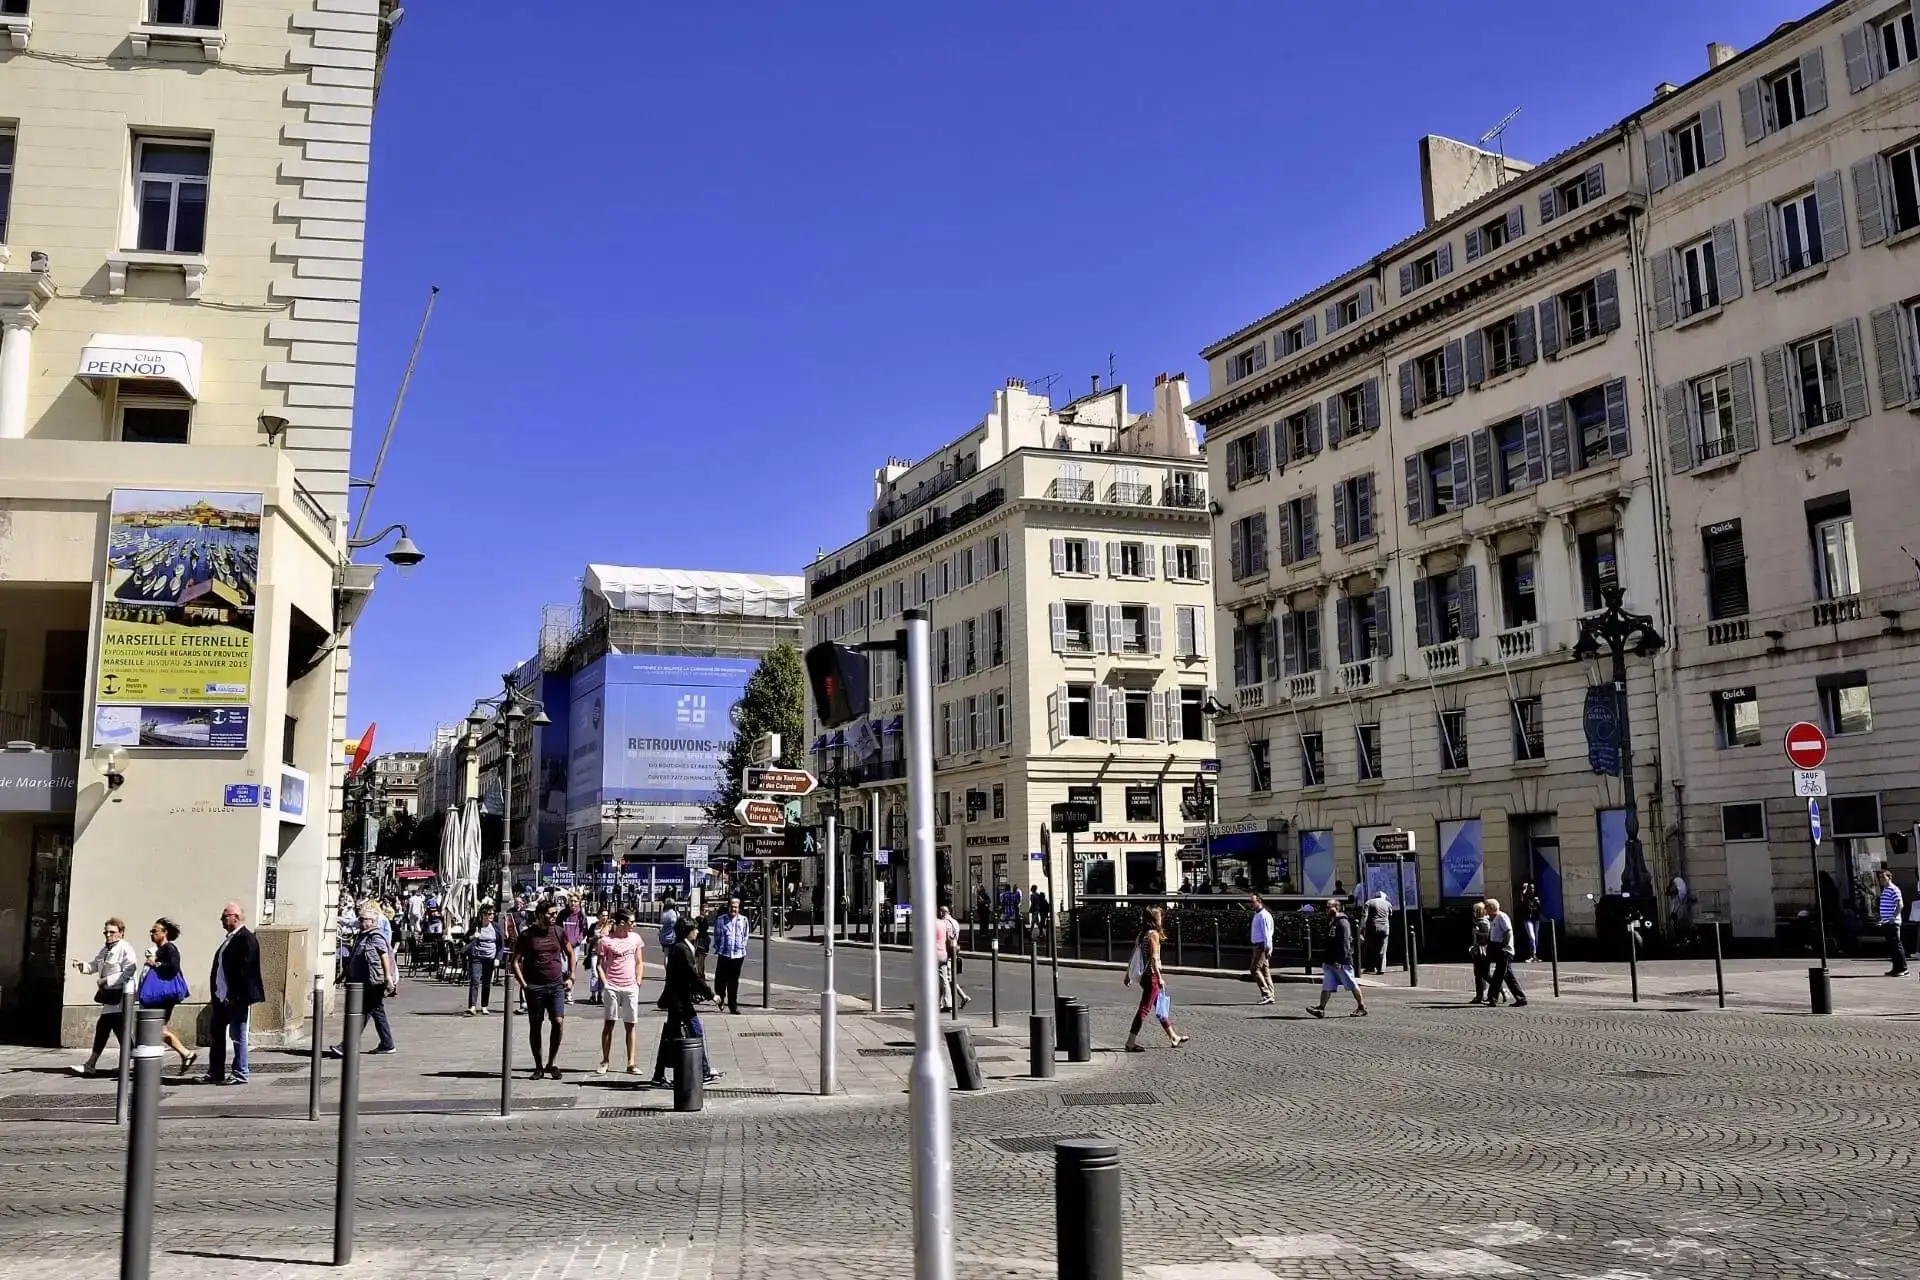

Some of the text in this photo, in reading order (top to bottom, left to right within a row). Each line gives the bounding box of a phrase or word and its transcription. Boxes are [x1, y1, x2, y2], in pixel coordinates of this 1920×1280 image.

[135, 354, 161, 362] Club
[87, 361, 165, 374] PERNOD
[1711, 522, 1733, 534] Quick
[106, 633, 248, 647] MARSEILLE ÉTERNELLE
[146, 648, 167, 656] MUSÉE
[1722, 689, 1745, 700] Quick
[0, 776, 74, 787] de Marseille
[1222, 823, 1257, 833] SOUVENIRS
[1094, 831, 1137, 842] FONCIA
